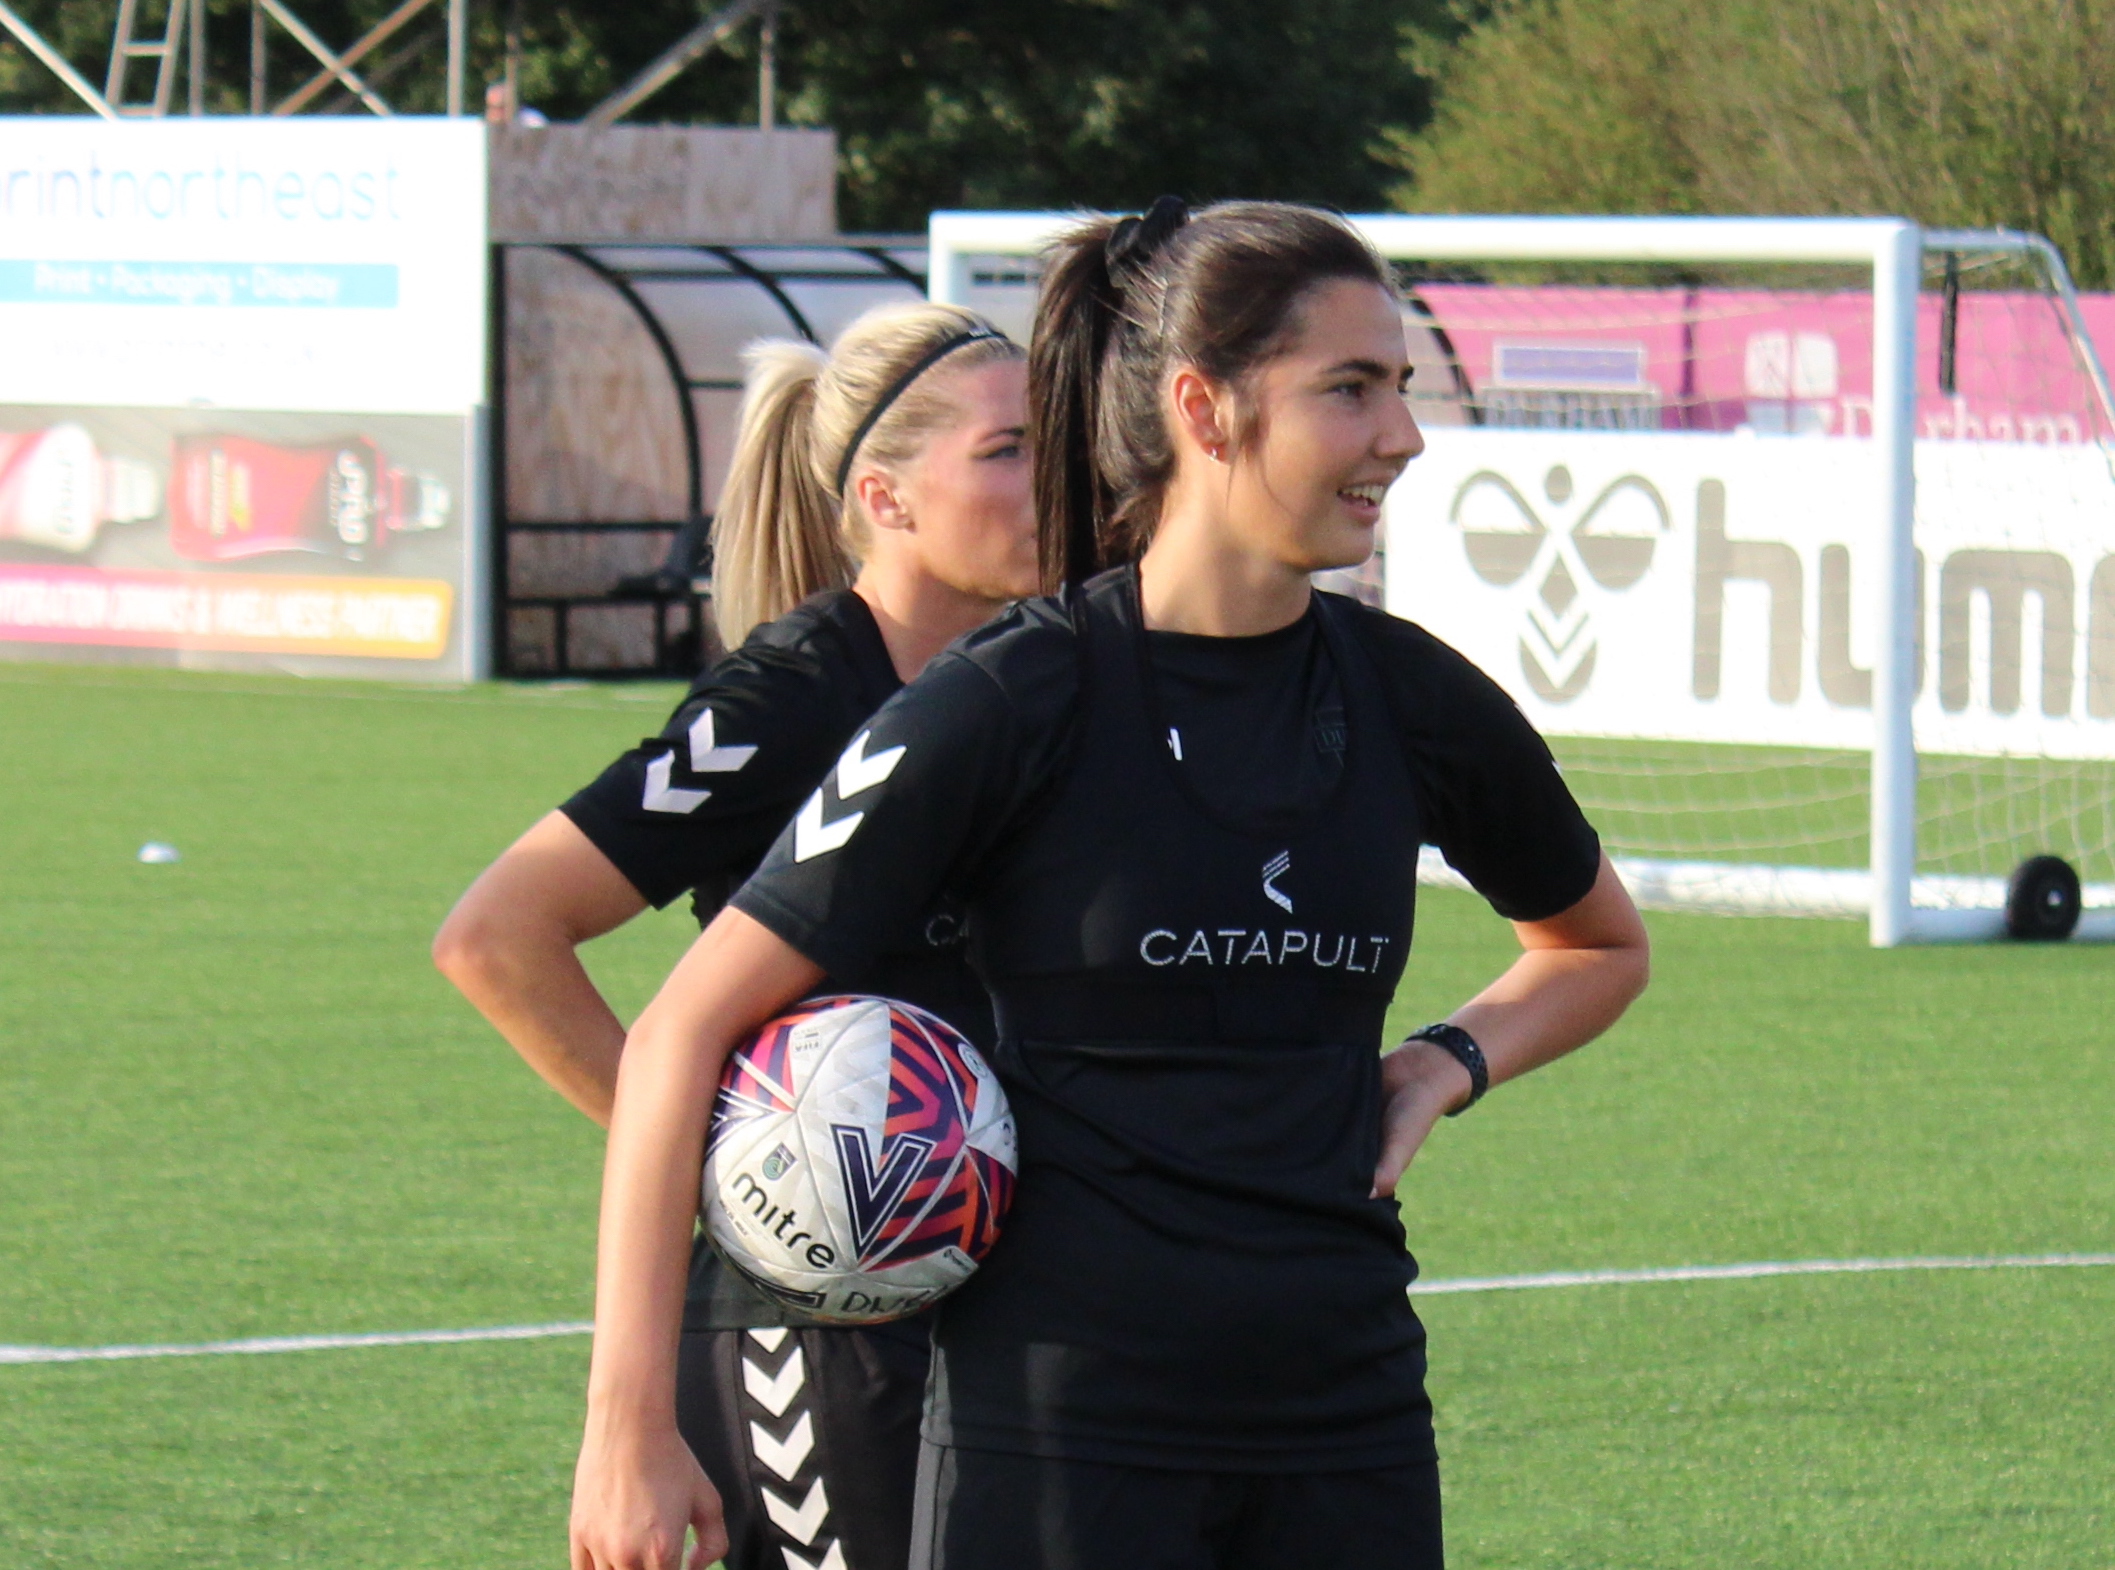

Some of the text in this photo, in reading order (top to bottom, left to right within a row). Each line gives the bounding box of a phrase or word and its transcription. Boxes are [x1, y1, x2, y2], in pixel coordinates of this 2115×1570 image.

[0, 148, 401, 222] rintnortheast
[35, 261, 91, 294] Print
[1840, 394, 2084, 442] Drham
[1693, 478, 2115, 720] hum
[1140, 929, 1389, 973] CATAPULT
[732, 1172, 835, 1269] mitre
